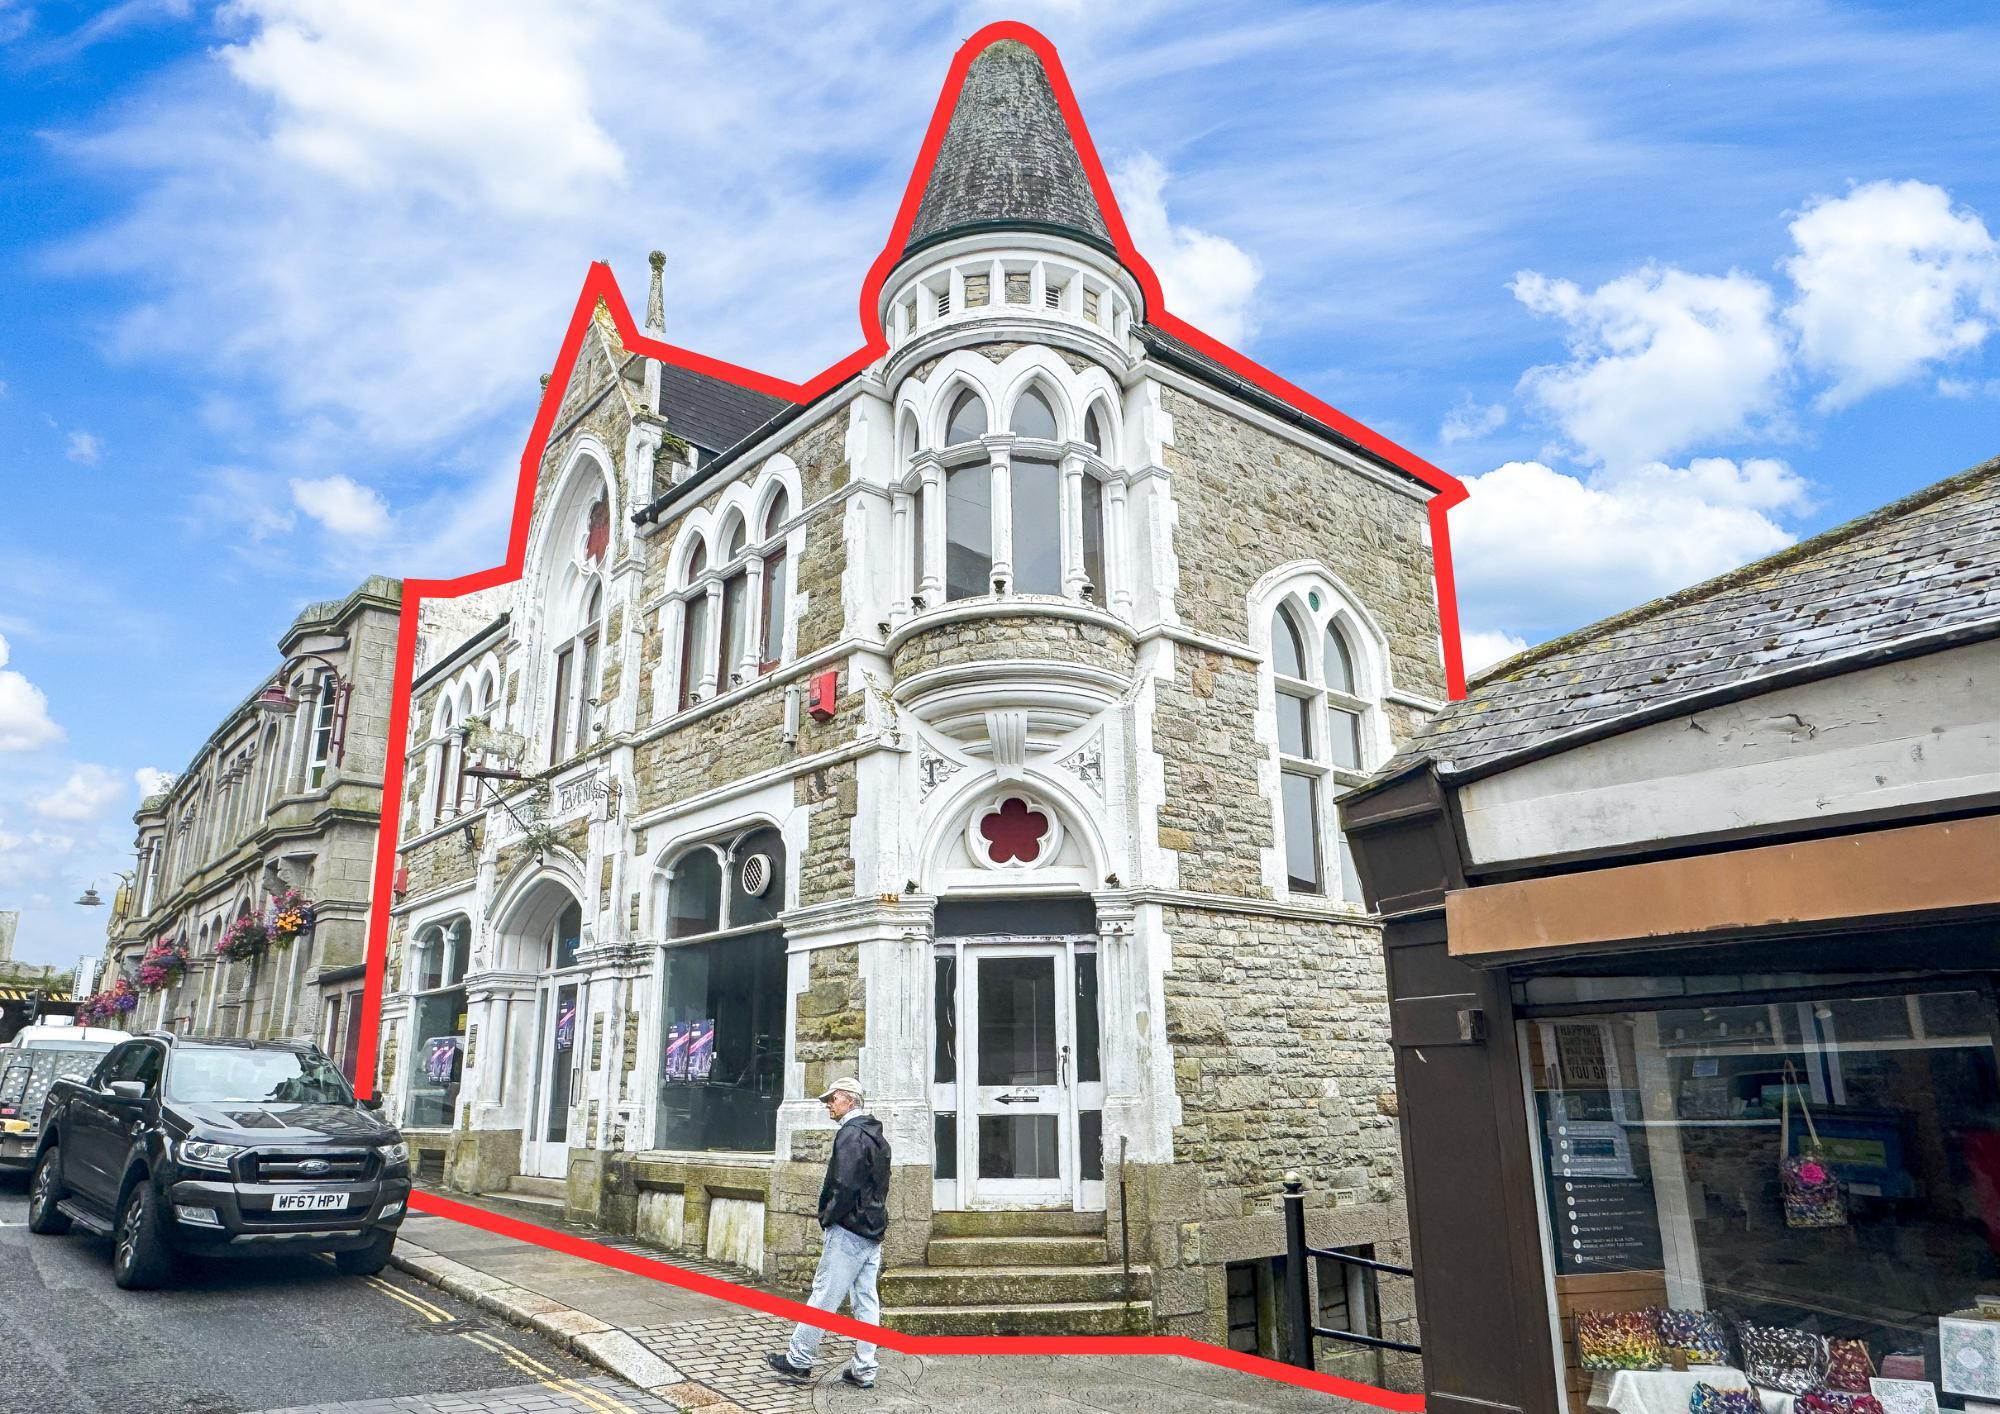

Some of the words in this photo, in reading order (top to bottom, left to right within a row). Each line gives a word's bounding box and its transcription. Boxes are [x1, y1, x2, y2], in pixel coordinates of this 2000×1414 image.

[1568, 1066, 1590, 1079] YOU
[279, 1196, 315, 1209] WF67
[317, 1194, 344, 1208] HPY
